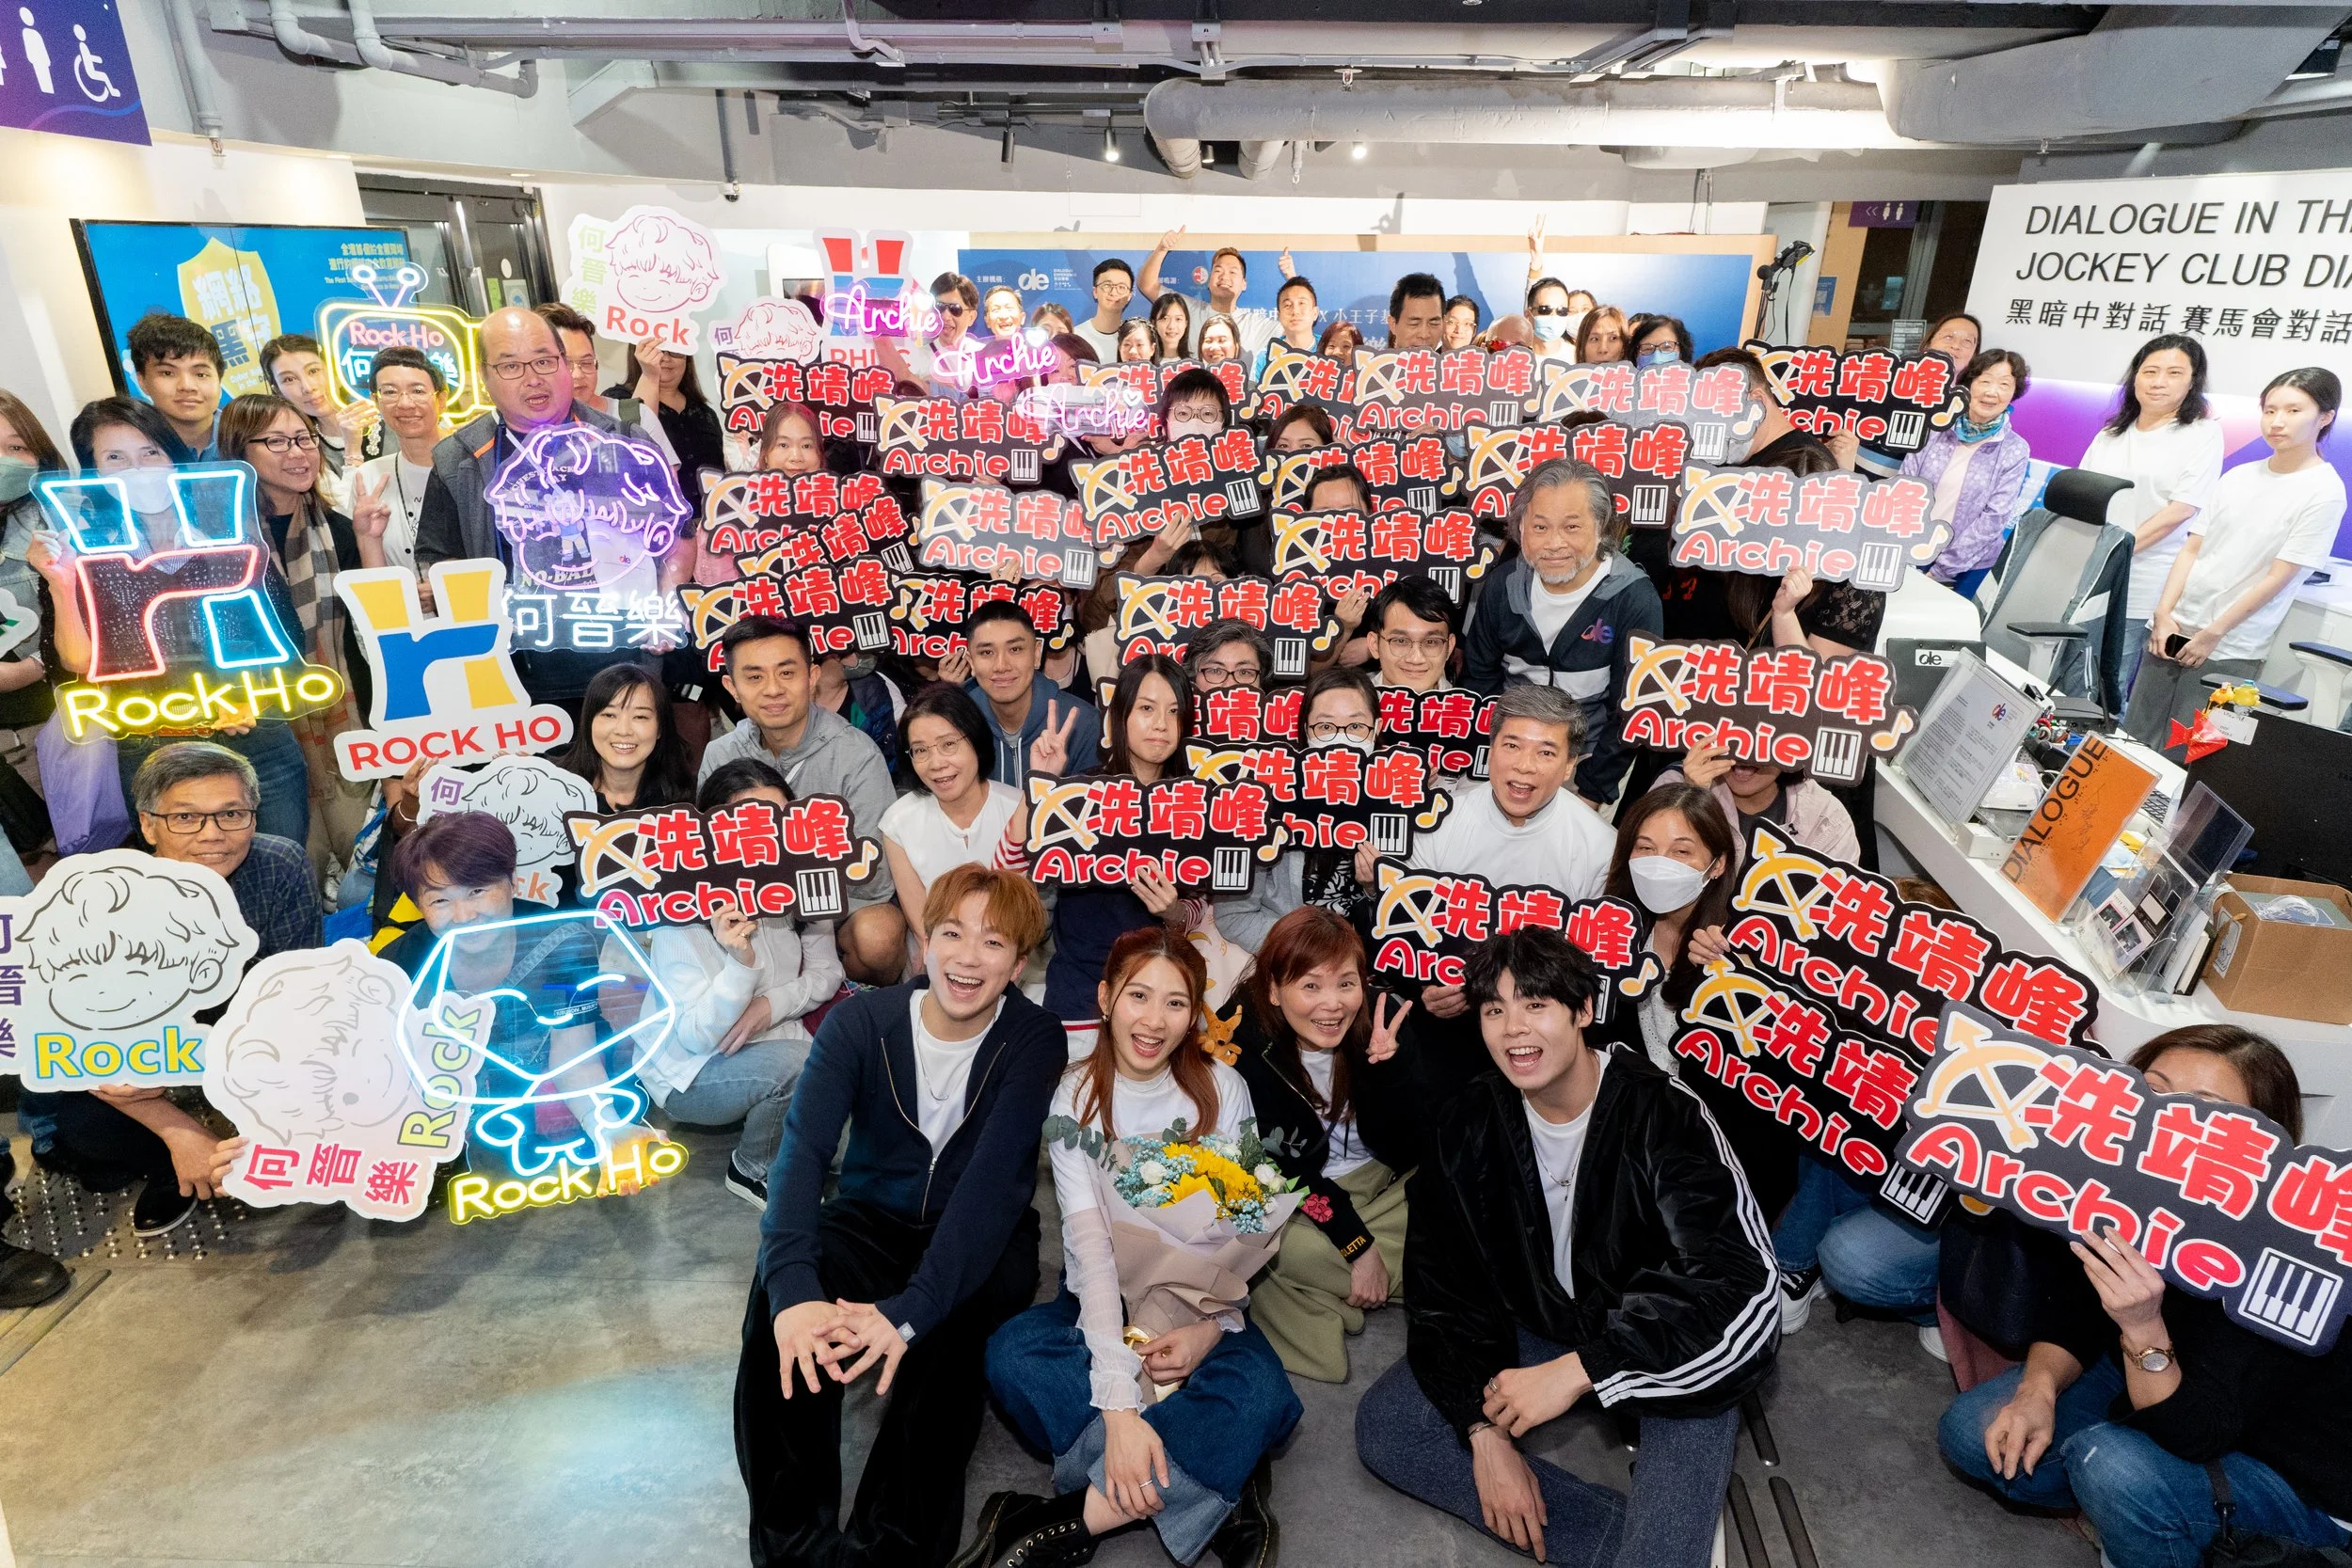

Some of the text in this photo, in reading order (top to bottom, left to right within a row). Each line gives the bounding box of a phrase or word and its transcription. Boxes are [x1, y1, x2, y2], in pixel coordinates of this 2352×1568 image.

[2026, 198, 2352, 235] DIALOGUE IN TH
[2015, 251, 2352, 289] JOCKEY CLUB DI
[348, 321, 445, 350] Rock Ho
[605, 304, 691, 346] Rock
[2005, 297, 2352, 344] 黑暗中對話 賽馬會對話
[882, 446, 1010, 477] Archie
[1096, 493, 1229, 545] Archie
[922, 534, 1063, 577] Archie
[1676, 531, 1858, 578] Archie
[65, 667, 336, 737] Rock Ho
[348, 714, 564, 771] ROCK HO
[1622, 707, 1813, 768] Archie
[1998, 734, 2108, 884] DIALOGUE
[1033, 846, 1213, 886] Archie
[593, 878, 797, 930] Archie
[1726, 914, 1939, 1058] Archie
[34, 1025, 206, 1080] Rock
[397, 1005, 482, 1149] Rock
[1674, 1027, 1889, 1177] Archie
[243, 1142, 420, 1206] 何晉樂
[453, 1143, 682, 1221] Rock Ho
[1905, 1120, 2248, 1292] Archie
